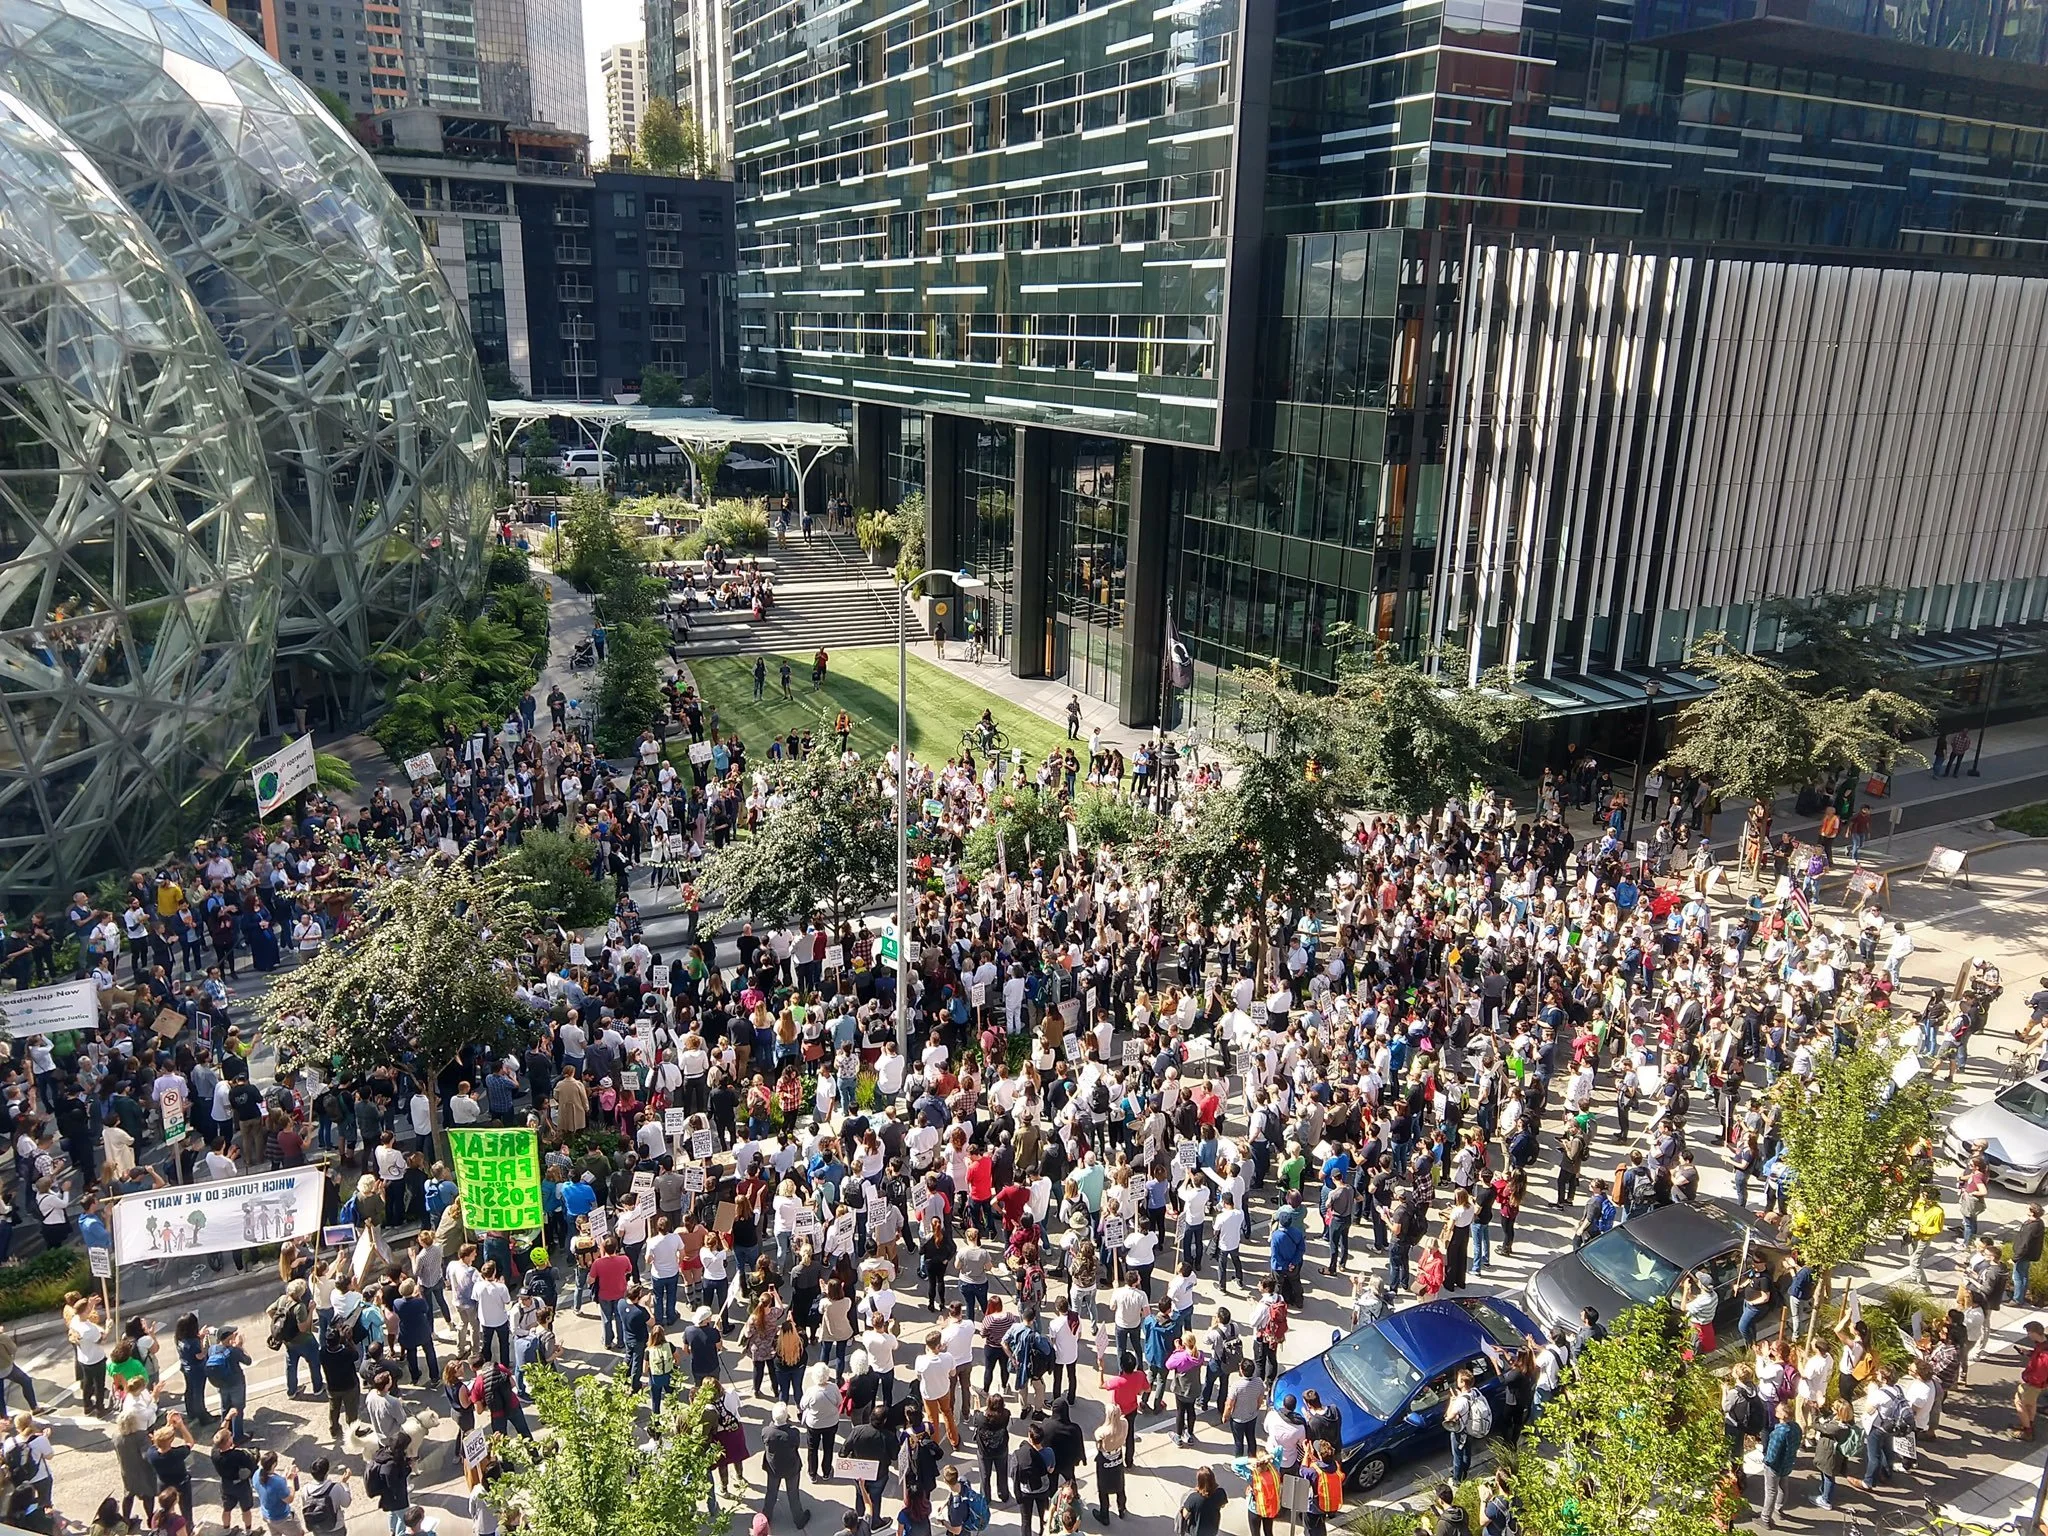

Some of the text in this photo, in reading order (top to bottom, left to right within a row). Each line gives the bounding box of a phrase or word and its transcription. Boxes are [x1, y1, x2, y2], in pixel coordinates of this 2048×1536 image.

[887, 940, 893, 950] 4
[56, 988, 80, 997] Now
[38, 1017, 66, 1025] Climate
